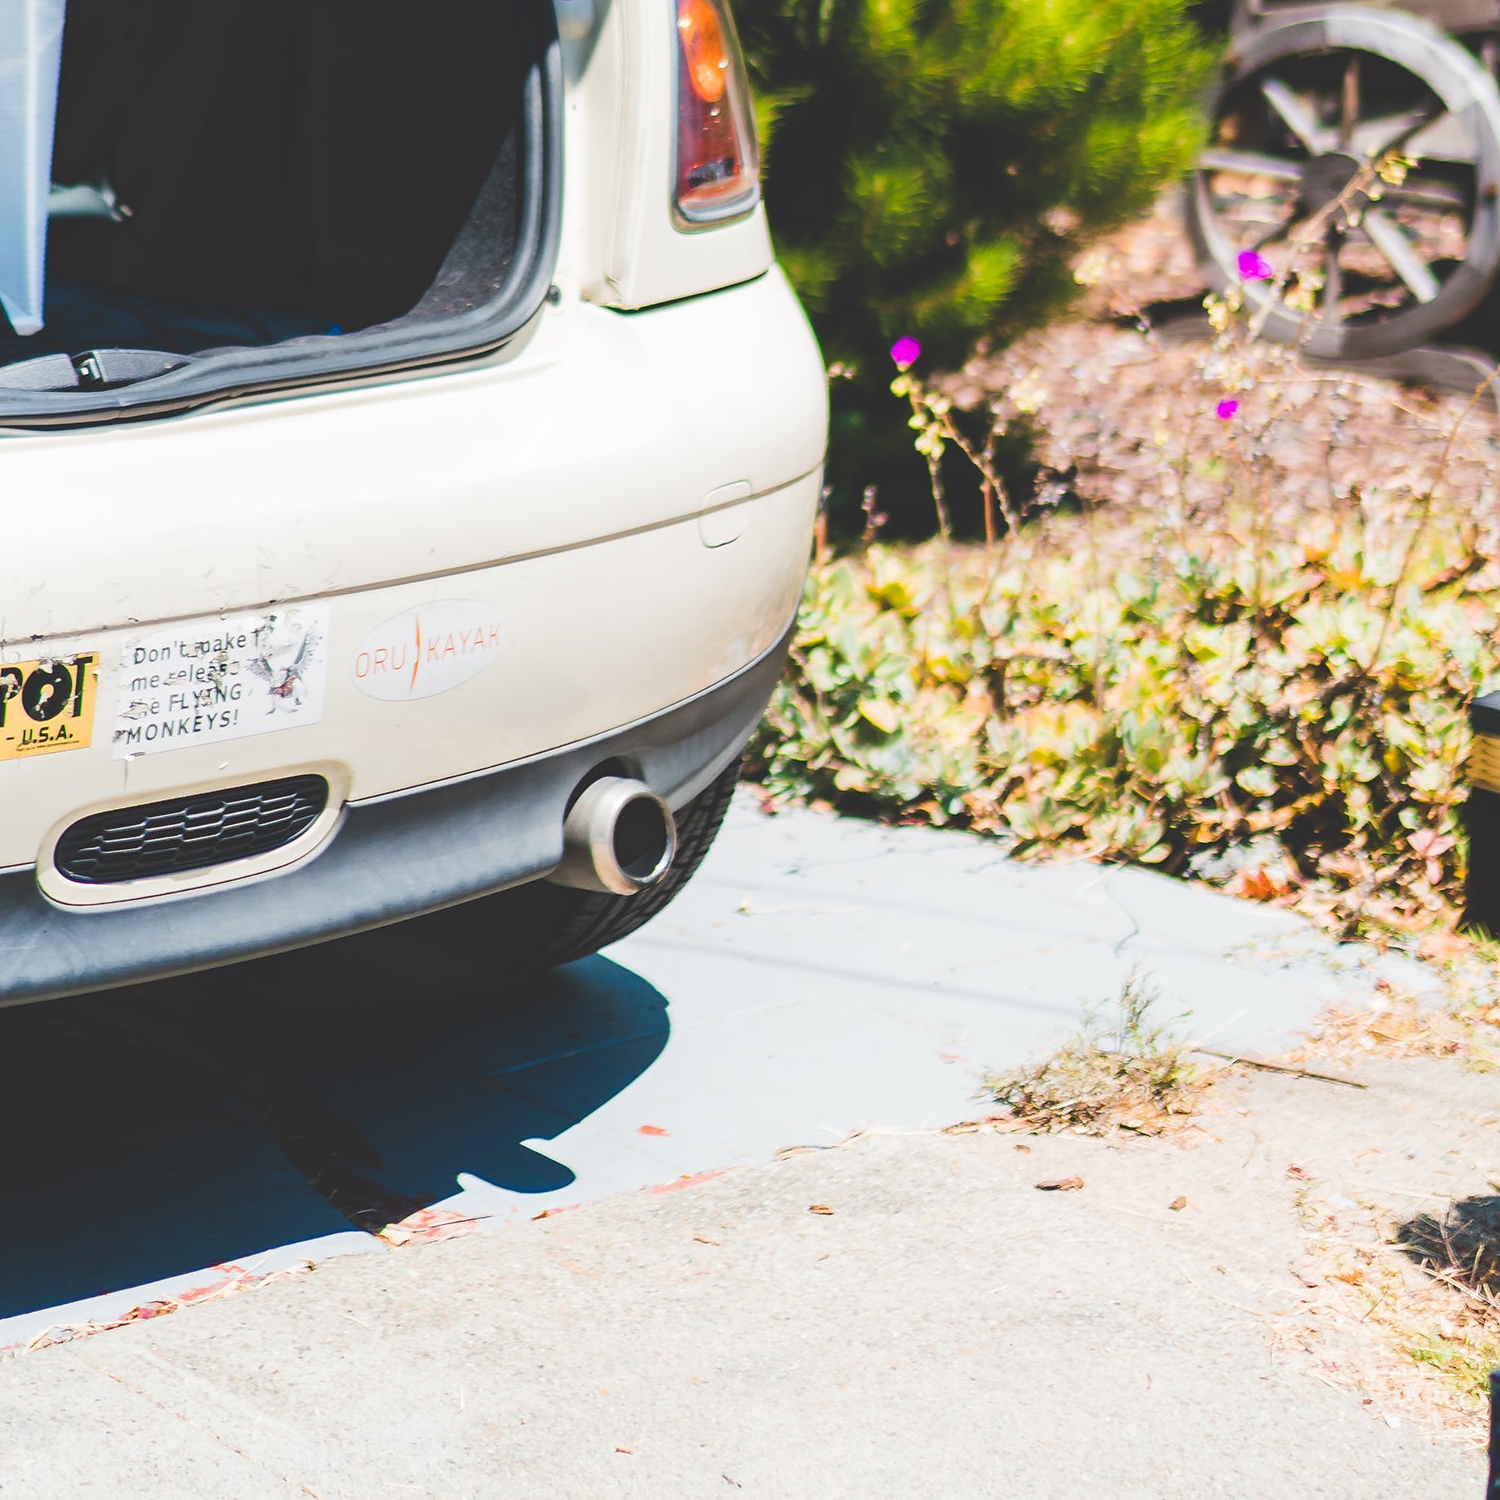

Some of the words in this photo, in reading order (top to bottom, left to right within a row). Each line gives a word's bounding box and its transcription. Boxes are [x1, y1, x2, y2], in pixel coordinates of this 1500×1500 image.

[133, 640, 188, 665] Don't
[355, 643, 406, 678] ORU
[426, 622, 501, 663] KAYAK
[131, 674, 160, 692] me
[22, 724, 73, 746] U.S.A.
[126, 708, 239, 745] MONKEYS!
